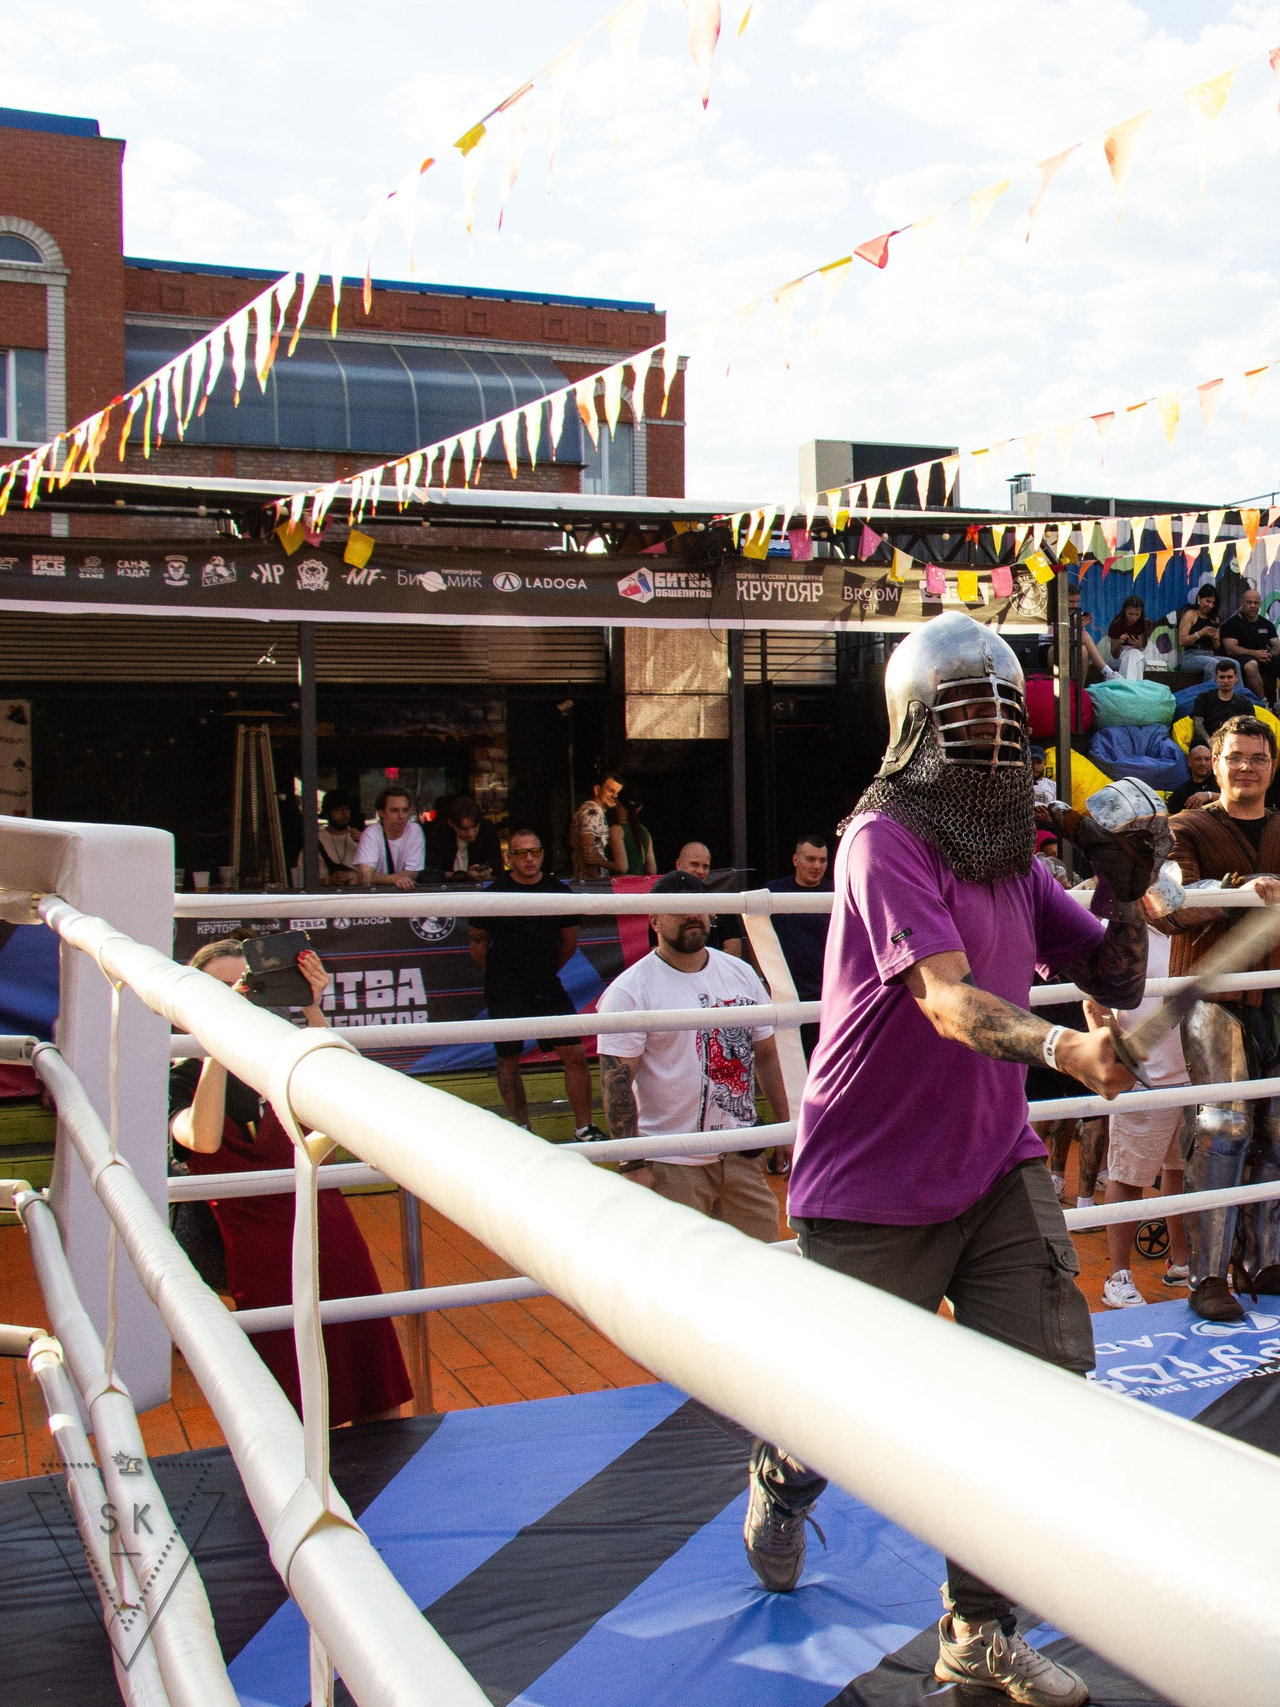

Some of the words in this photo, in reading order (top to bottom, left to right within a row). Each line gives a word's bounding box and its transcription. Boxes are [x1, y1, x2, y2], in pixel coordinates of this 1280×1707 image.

[117, 568, 150, 578] ИЗДАТ
[525, 577, 588, 590] LADOGA
[736, 580, 824, 603] КРУТОЯР
[862, 602, 880, 611] GIN
[352, 917, 392, 926] LADOGA
